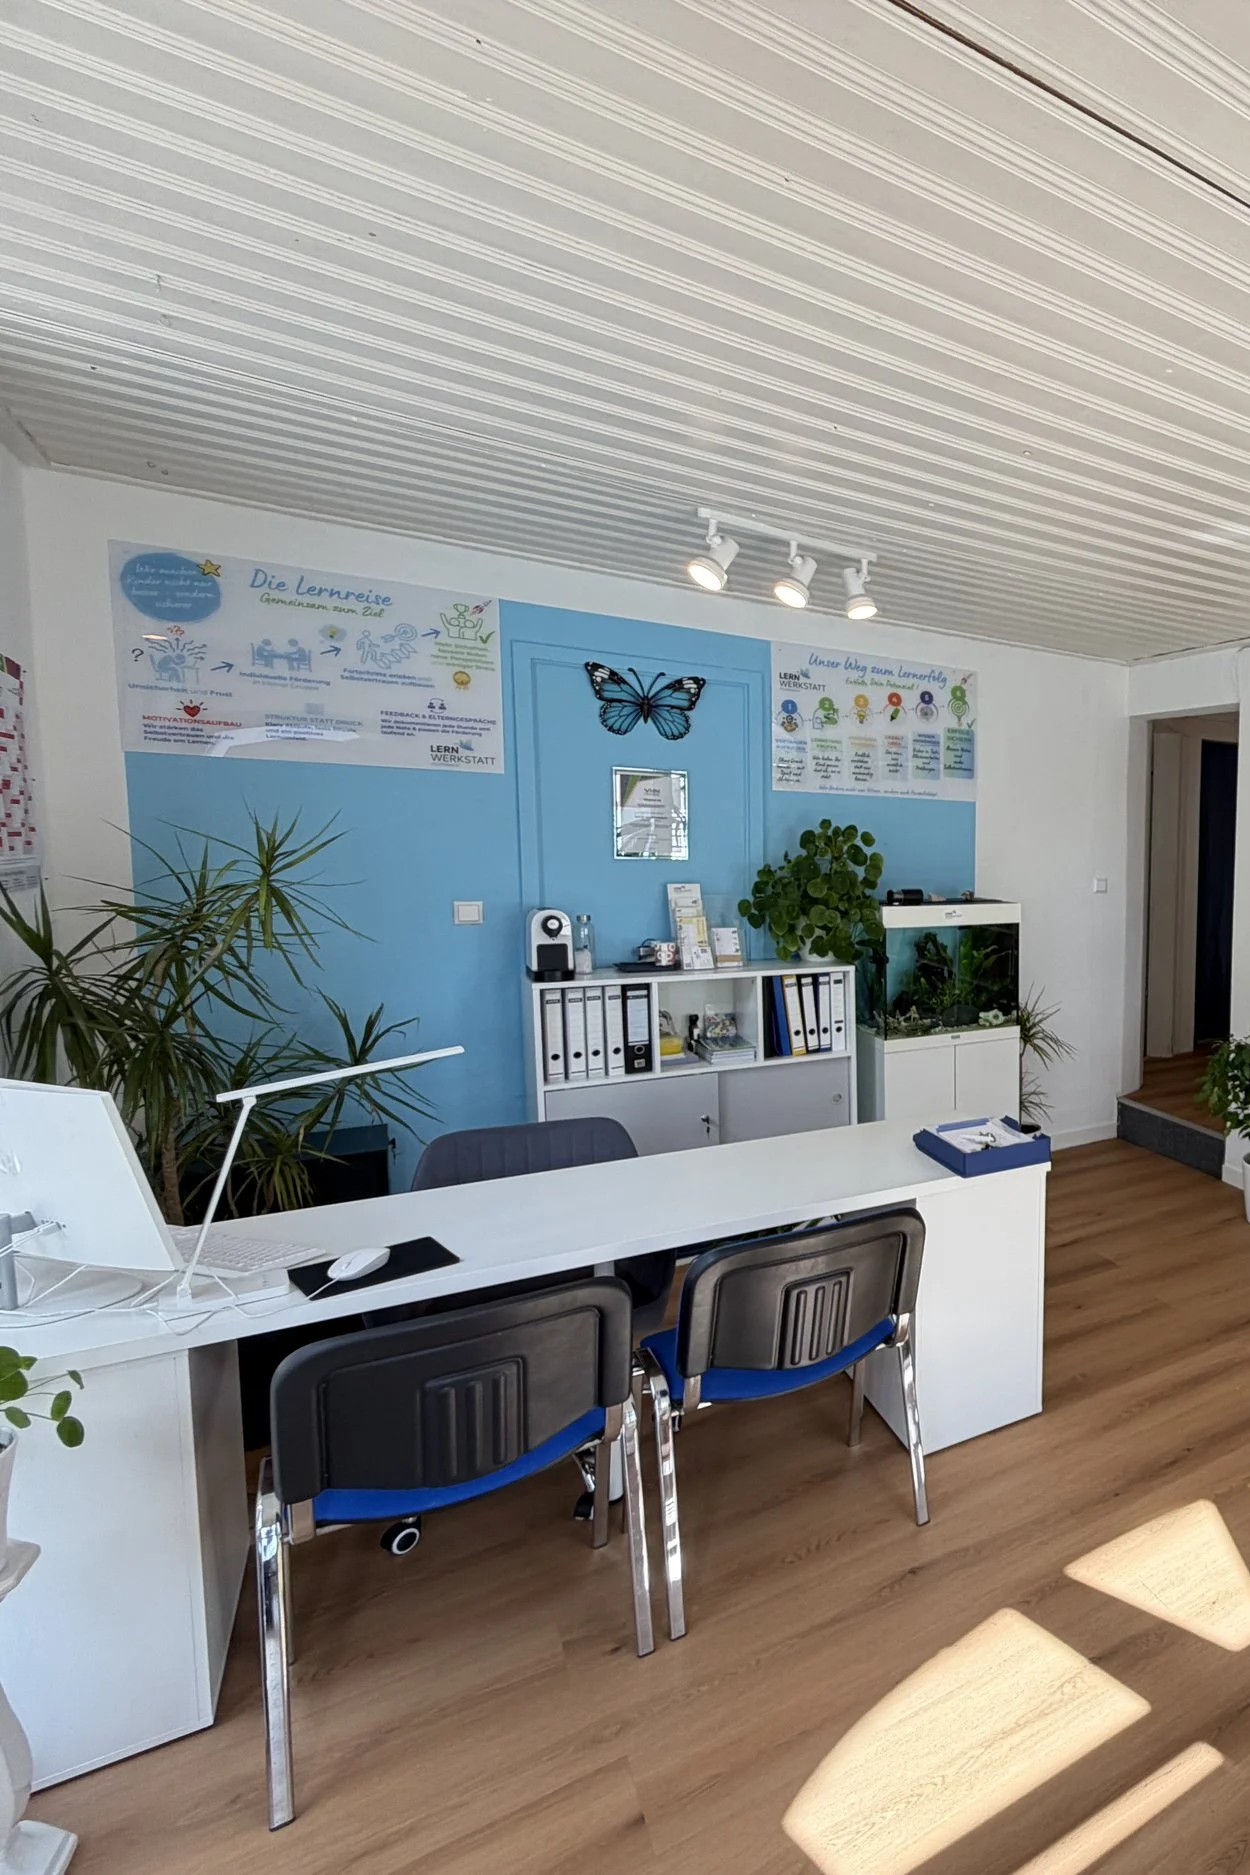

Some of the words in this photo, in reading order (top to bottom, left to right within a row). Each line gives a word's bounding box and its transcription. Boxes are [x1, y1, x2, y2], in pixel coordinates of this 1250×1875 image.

[250, 568, 288, 592] Die
[296, 575, 392, 607] Lernreise
[260, 592, 330, 611] Gemeinsam
[332, 606, 358, 615] zum
[362, 606, 385, 618] Ziel
[779, 672, 800, 681] LERN
[808, 653, 841, 668] Unser
[844, 656, 868, 678] Weg
[871, 666, 895, 677] zum
[898, 665, 948, 690] Lernerfolg
[779, 680, 826, 692] WERKSTATT
[142, 714, 242, 728] MOTIVATIONSAUFBAU
[380, 710, 419, 719] FEEDBACK
[430, 744, 459, 754] LERN
[430, 753, 496, 766] WERKSTATT
